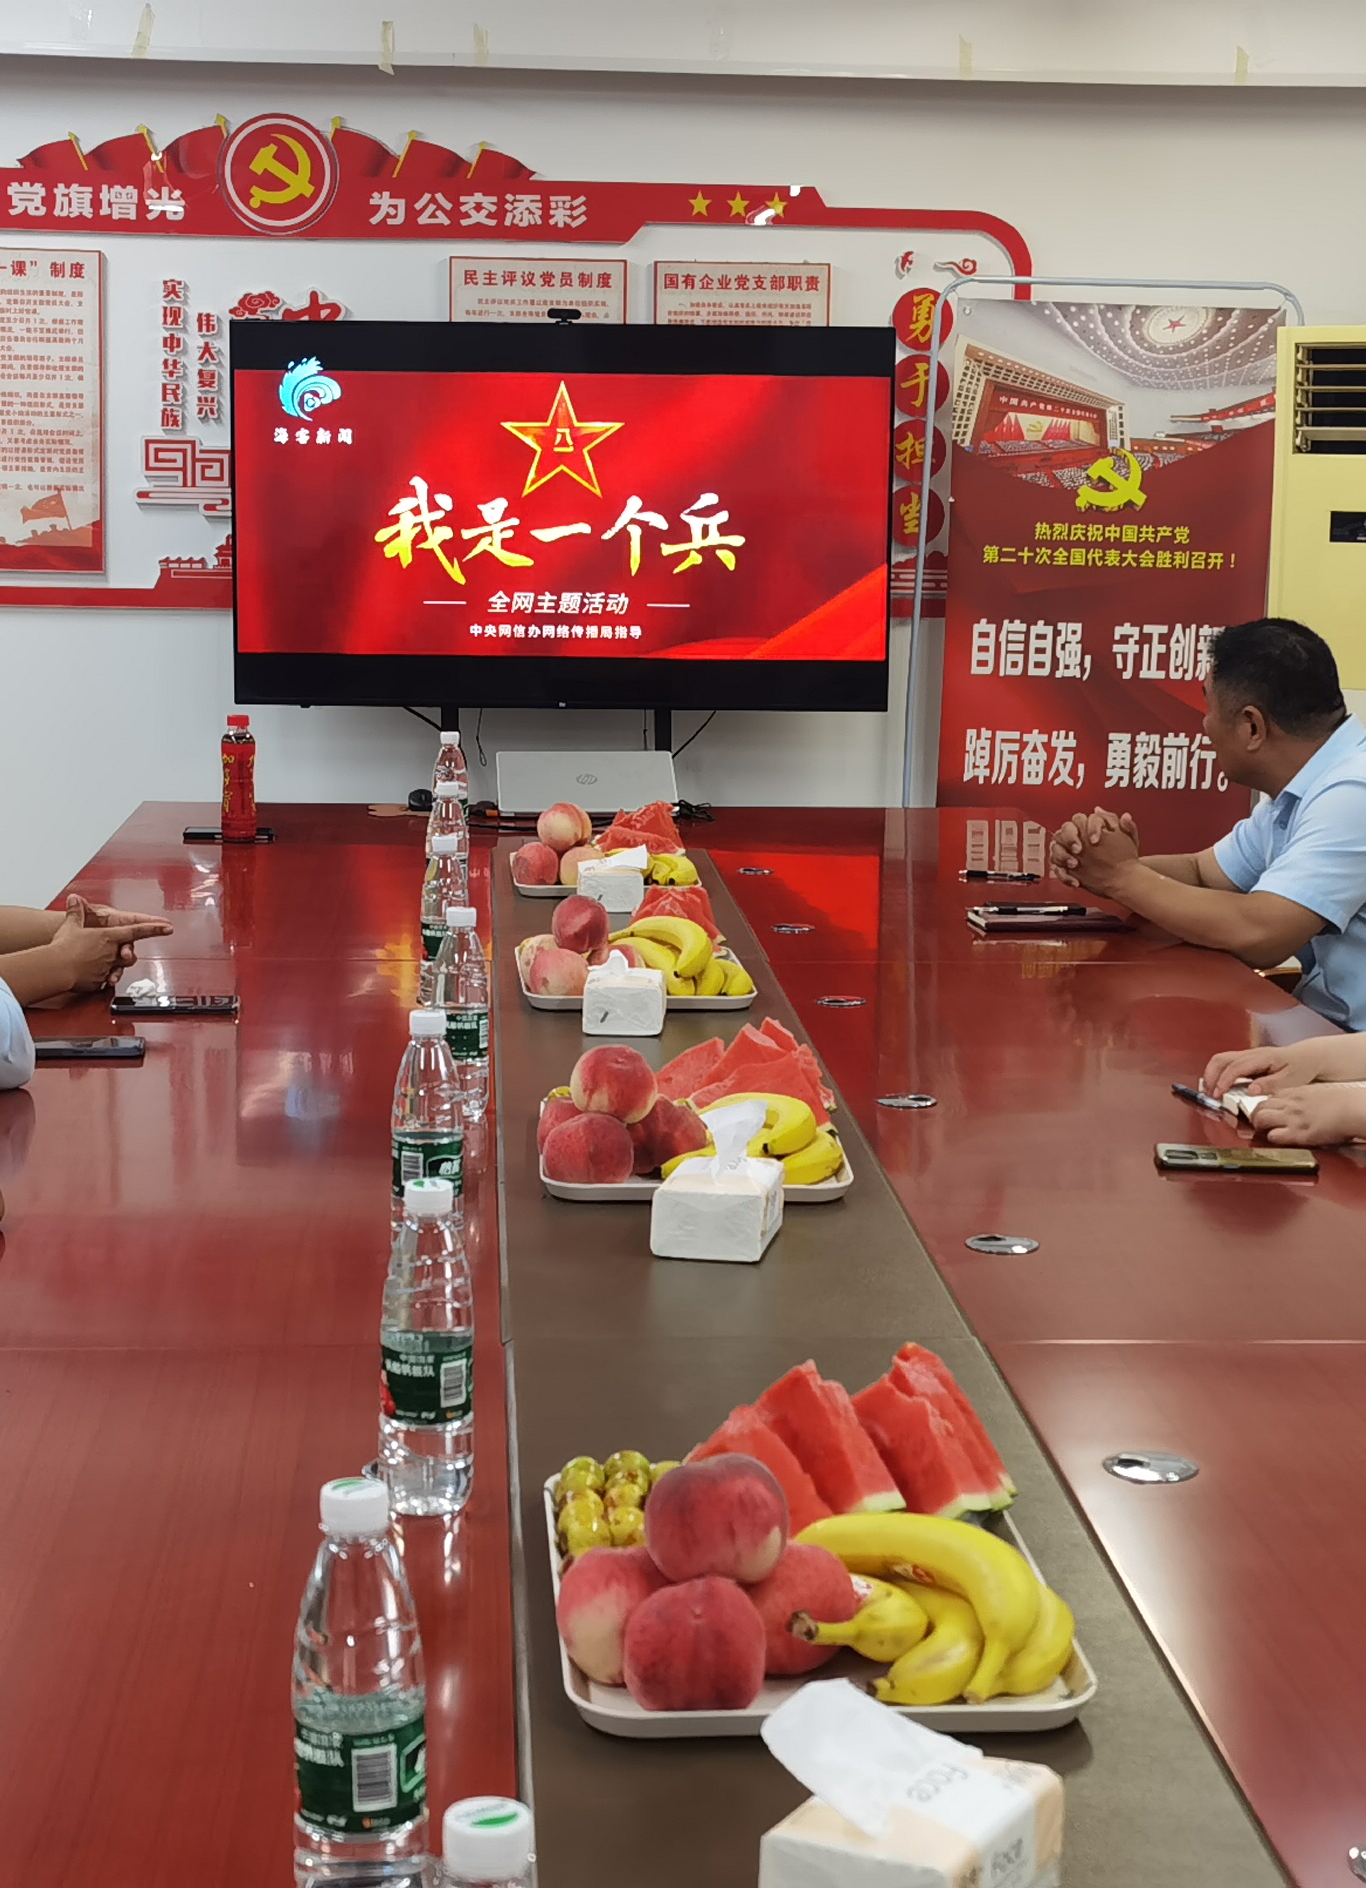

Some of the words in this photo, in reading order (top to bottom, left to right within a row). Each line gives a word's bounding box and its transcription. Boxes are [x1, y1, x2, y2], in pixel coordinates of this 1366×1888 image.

[369, 191, 587, 228] 为公交添彩
[463, 269, 613, 289] 民主评议党员制度
[663, 273, 820, 292] 国有企业党支部职责
[161, 278, 183, 428] 实现中华民族
[197, 312, 217, 418] 伟大复兴
[273, 427, 353, 445] 海客新闻
[374, 476, 746, 585] 我是一个兵
[1034, 521, 1191, 544] 热烈庆祝中国共产党
[982, 545, 1236, 570] 第二十次全国代表大会胜利召开！
[487, 590, 630, 616] 全网主题活动
[469, 623, 643, 640] 中央网信办网络传播局指导
